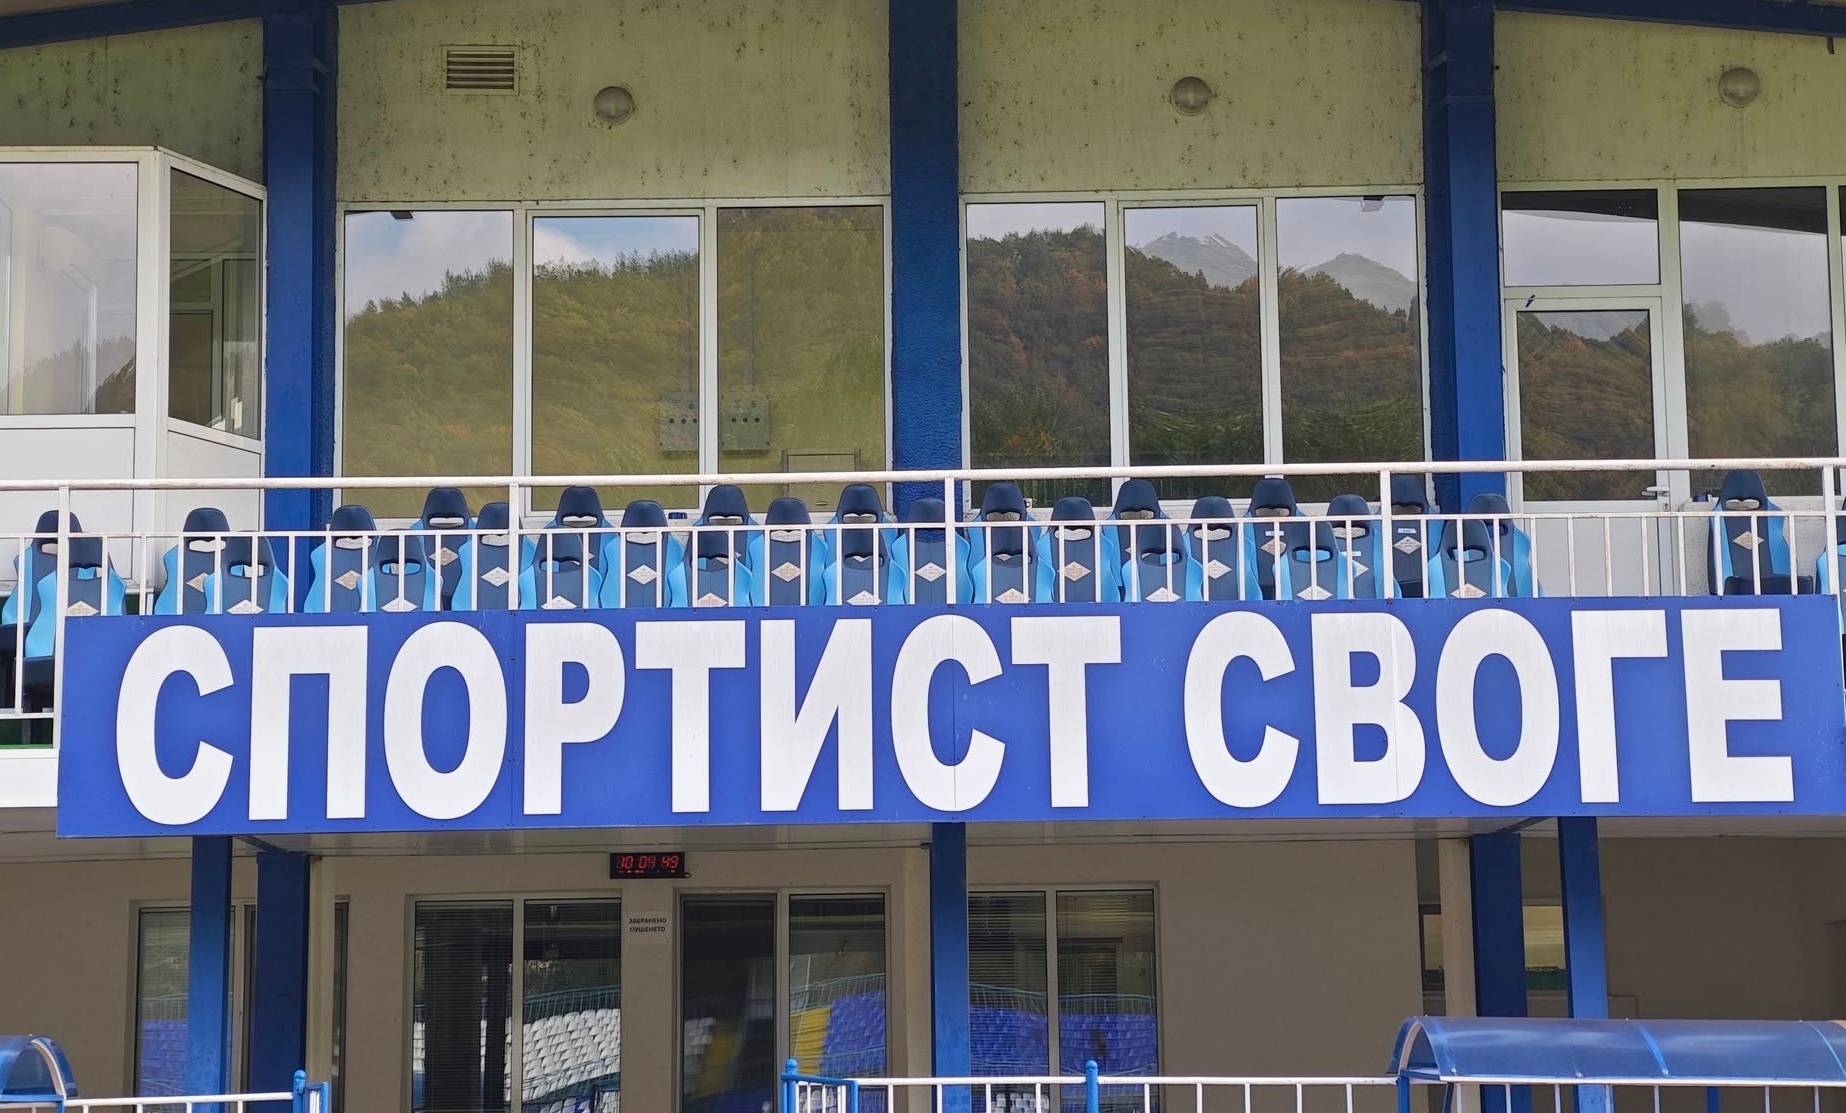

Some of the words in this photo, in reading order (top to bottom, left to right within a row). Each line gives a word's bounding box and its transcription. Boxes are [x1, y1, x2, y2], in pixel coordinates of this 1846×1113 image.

[116, 614, 1122, 824] СПОРТИСТ
[1183, 608, 1795, 808] СВОГЕ
[620, 855, 634, 869] 10
[628, 917, 668, 925] ЗАБРАНЕНО
